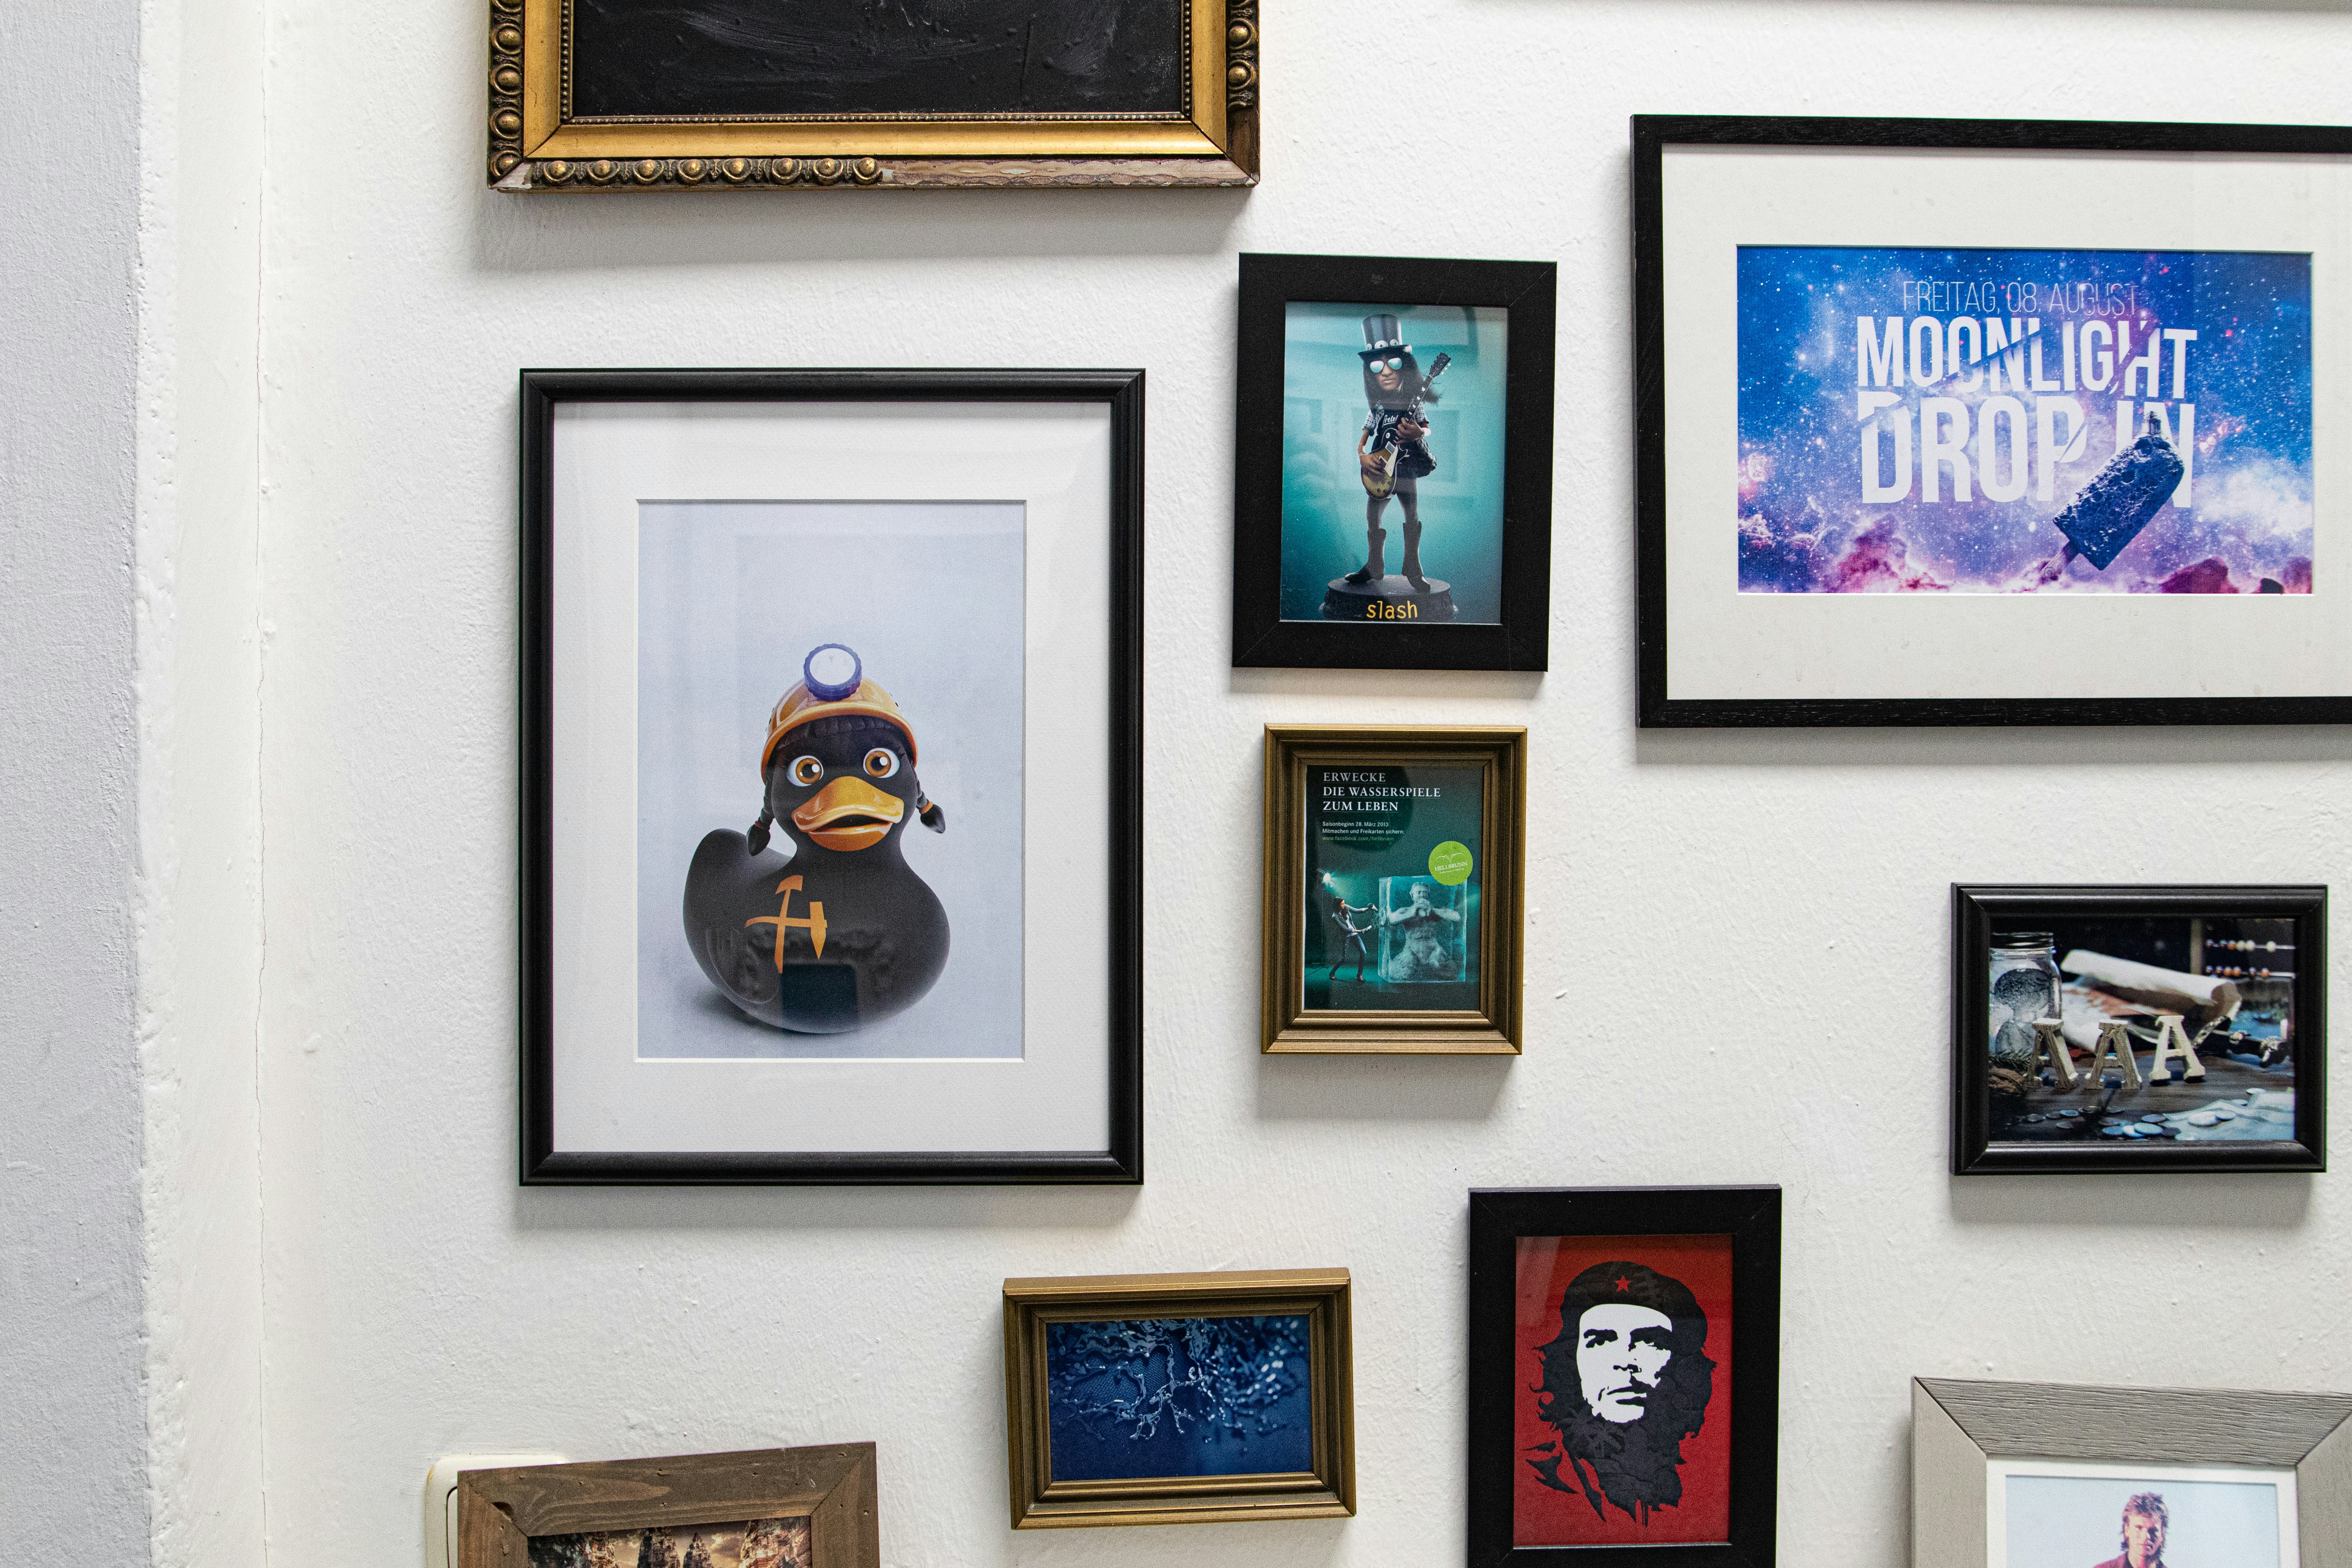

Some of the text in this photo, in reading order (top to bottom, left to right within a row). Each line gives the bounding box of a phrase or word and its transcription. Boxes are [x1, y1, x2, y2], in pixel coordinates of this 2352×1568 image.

[1903, 281, 2000, 314] FREITAG,
[2049, 282, 2140, 316] AUGUST
[1857, 316, 2198, 399] MOONLIGHT
[1857, 391, 2088, 503] DROP
[1366, 601, 1418, 619] slash
[1323, 772, 1386, 782] ERWECKE
[1323, 786, 1441, 797] DIE WASSERSPIELE
[1323, 801, 1399, 811] ZUM LEBEN
[1435, 861, 1468, 871] HELLBRUNN
